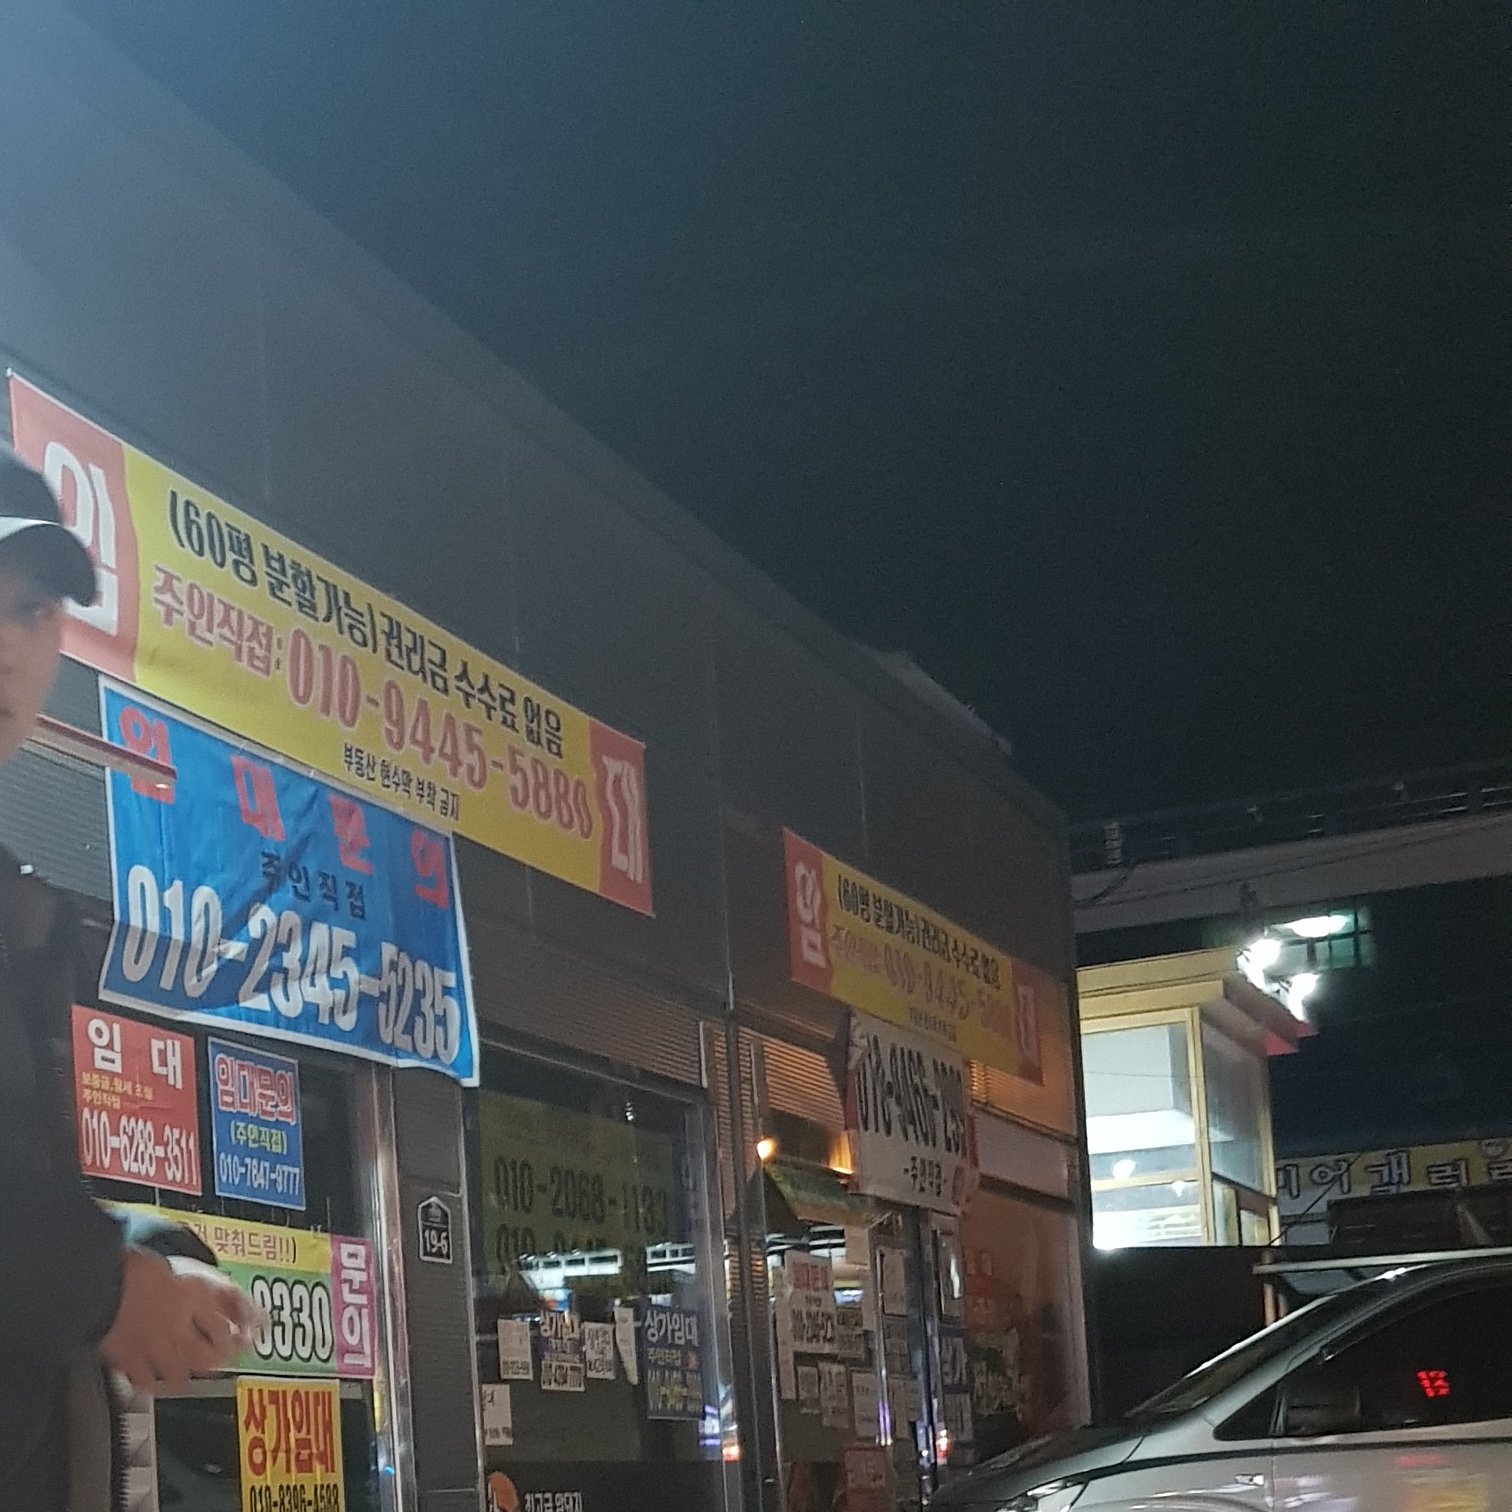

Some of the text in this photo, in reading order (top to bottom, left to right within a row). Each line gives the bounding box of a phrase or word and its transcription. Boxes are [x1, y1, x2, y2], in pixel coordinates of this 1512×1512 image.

[169, 489, 258, 587] (60평
[380, 610, 449, 697] 권리금
[454, 659, 519, 734] 수수료
[524, 696, 563, 760] 없음
[344, 742, 460, 822] 부동산 현수막 부착 금지
[602, 755, 643, 884] 대
[121, 865, 460, 1065] 010-2345-5235
[215, 1053, 297, 1126] 임대문의
[81, 1107, 197, 1187] 010-6288-3511
[229, 1120, 287, 1155] (주인직접)
[214, 1226, 296, 1264] 맞춰드림!!)
[340, 1243, 373, 1368] 문의
[645, 1309, 699, 1348] 상가임대
[243, 1388, 335, 1477] 상가임대
